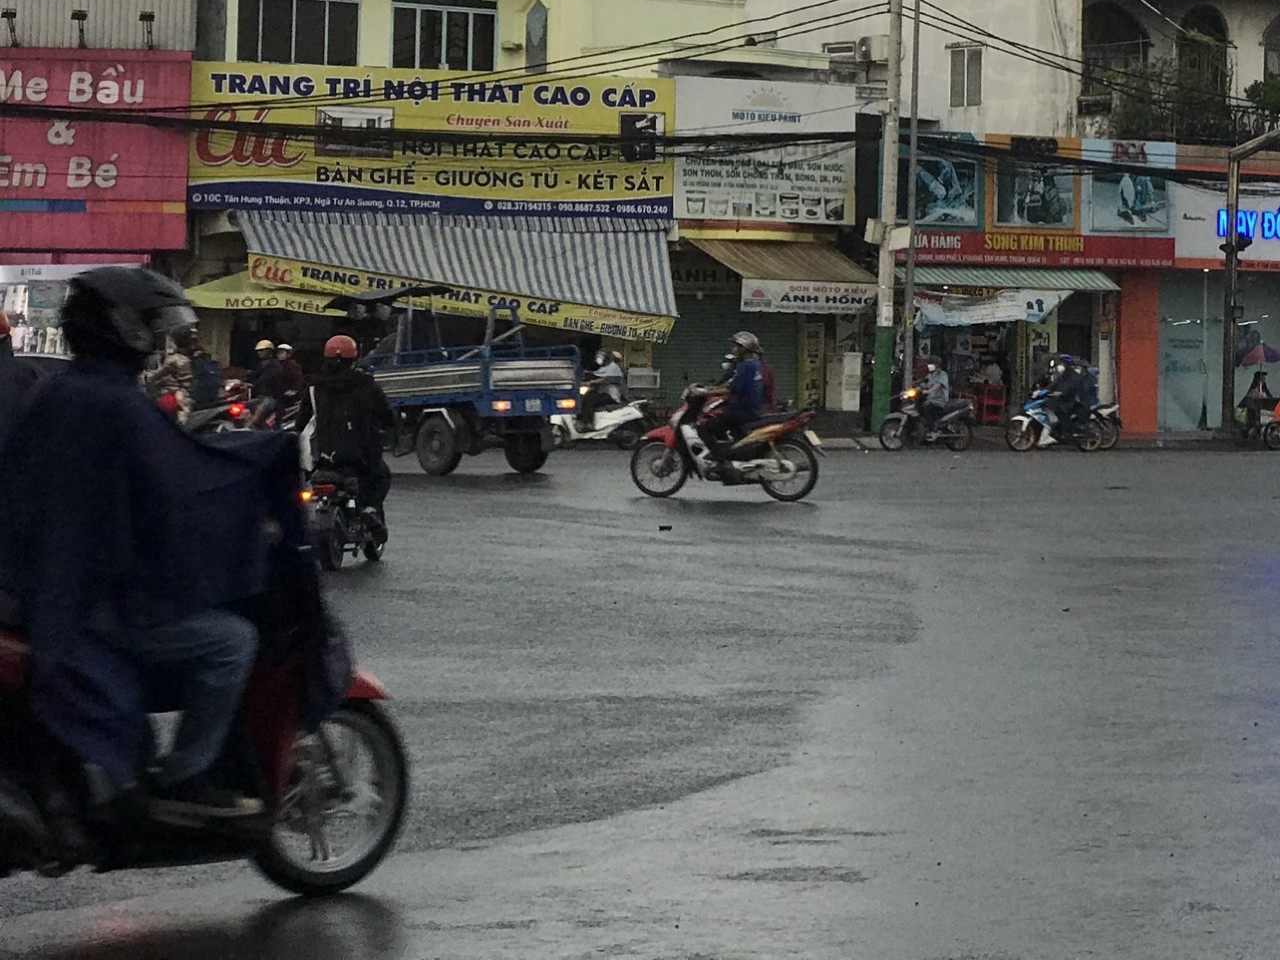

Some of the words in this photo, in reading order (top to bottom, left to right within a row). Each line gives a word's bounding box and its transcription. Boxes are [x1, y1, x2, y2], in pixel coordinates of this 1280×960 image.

[69, 63, 145, 104] Bầu
[211, 73, 315, 97] TRANG
[325, 74, 372, 98] TRÍ
[384, 76, 440, 106] NỘI
[534, 86, 591, 107] CAO
[601, 82, 656, 108] CẤP
[47, 120, 76, 145] &
[196, 106, 306, 167] Cúc
[513, 141, 561, 160] CAO
[67, 153, 119, 188] Bé
[316, 161, 362, 183] BÀN
[370, 160, 416, 185] GHẾ
[435, 166, 524, 188] GIƯỜNG
[530, 166, 558, 188] TỦ
[578, 169, 618, 190] KÉT
[203, 193, 221, 203] 10C
[294, 196, 312, 207] KP3,
[386, 199, 408, 209] Q.12,
[498, 201, 552, 211] 028.37194315
[616, 204, 668, 214] 0986.670.240
[931, 234, 961, 249] HÀNG
[984, 234, 1018, 251] SONG
[1020, 235, 1045, 252] KIM
[1049, 237, 1084, 255] THỊNH
[251, 257, 293, 284] Cúc
[300, 266, 361, 286] TRANG
[366, 275, 394, 290] TRÍ
[487, 294, 521, 310] CAO
[780, 292, 819, 303] ÁNH
